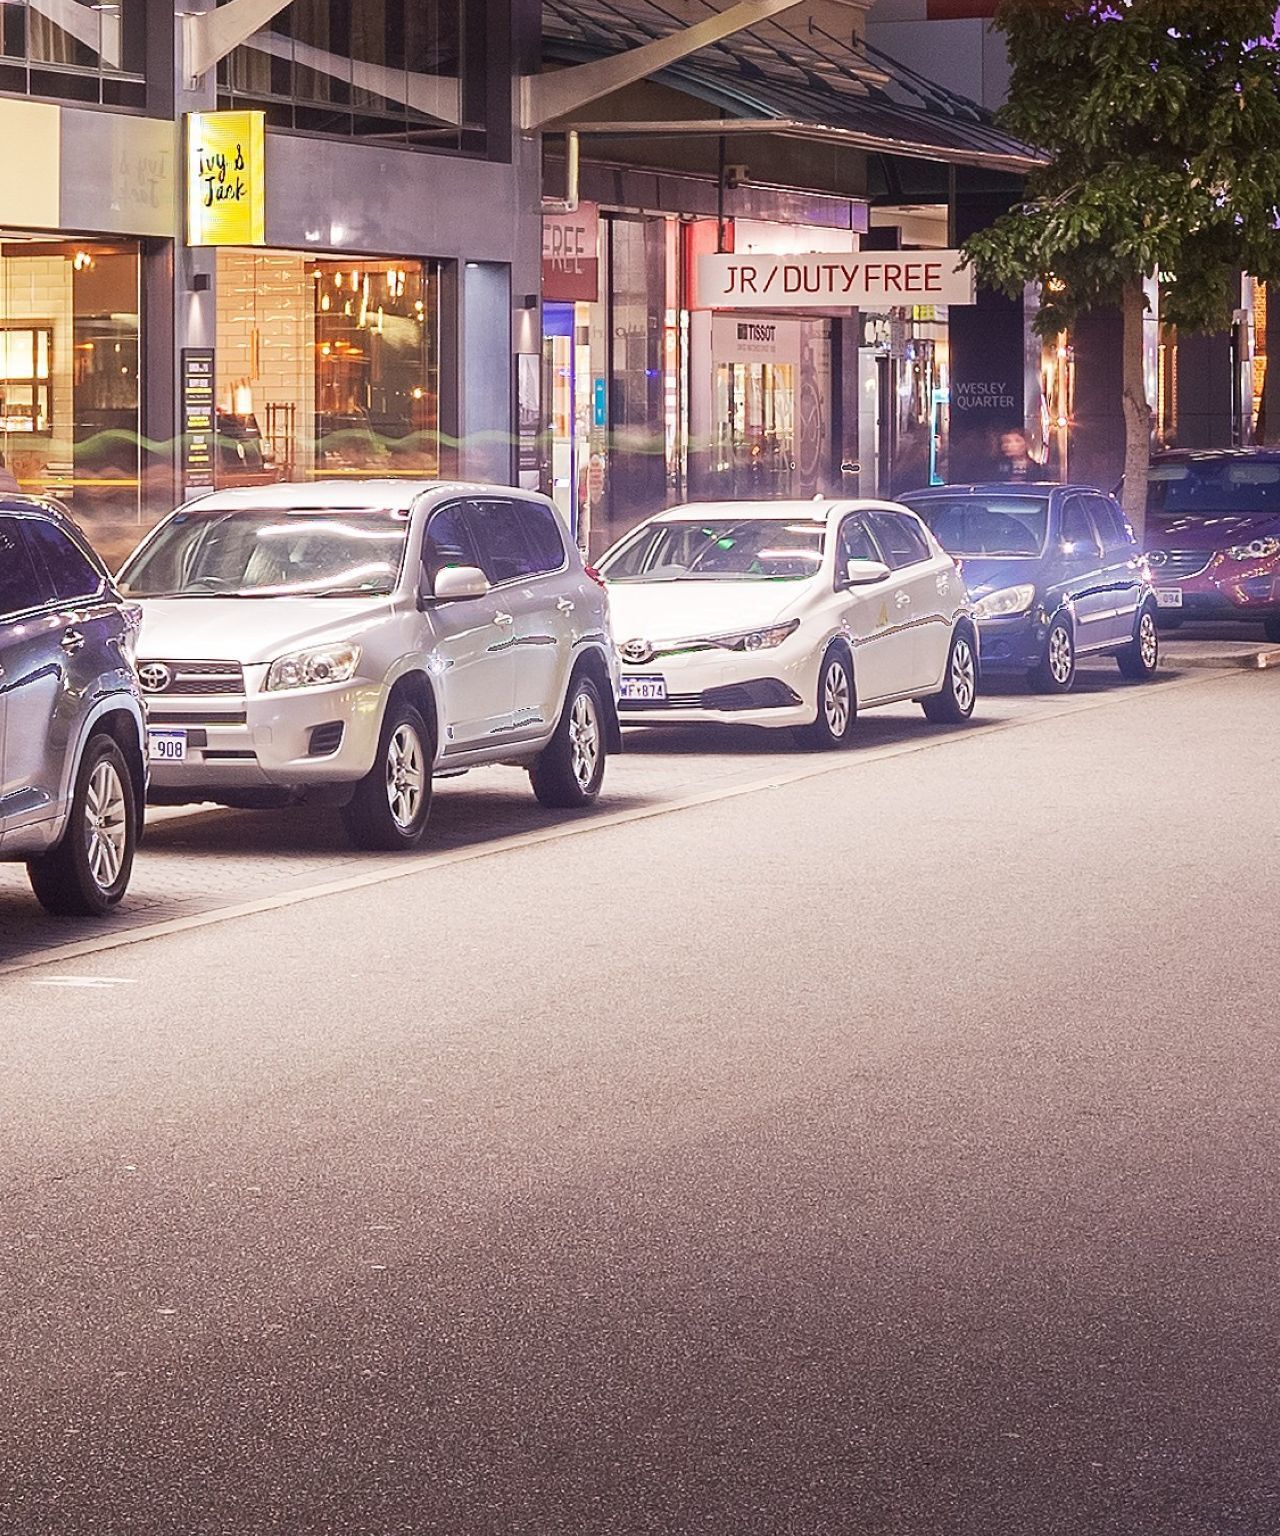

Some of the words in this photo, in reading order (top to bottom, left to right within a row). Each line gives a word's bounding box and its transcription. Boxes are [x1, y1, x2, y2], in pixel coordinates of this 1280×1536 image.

[196, 148, 226, 183] Ivy
[204, 176, 247, 207] Jack
[723, 266, 758, 294] JR
[783, 263, 859, 293] DUTY
[864, 263, 942, 292] FREE
[748, 324, 777, 342] TISSOT
[956, 382, 1007, 395] WESLEY
[956, 395, 1015, 411] QUARTER
